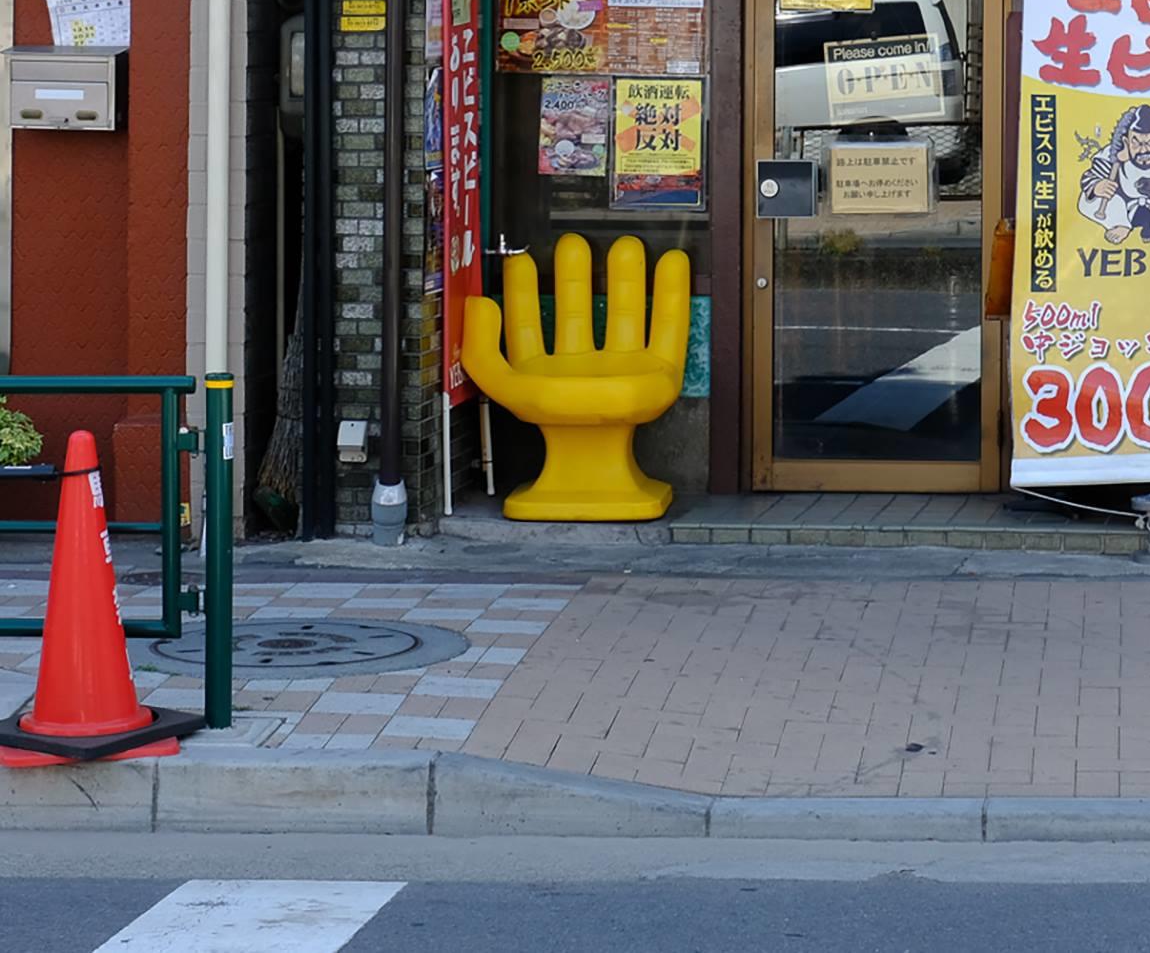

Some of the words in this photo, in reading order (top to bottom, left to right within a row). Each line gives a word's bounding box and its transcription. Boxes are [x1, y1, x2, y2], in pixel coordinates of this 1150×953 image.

[833, 47, 875, 61] Please
[878, 44, 912, 57] come
[837, 61, 934, 96] OPEN
[628, 84, 690, 100] 飲酒運転
[635, 103, 683, 126] 絶対
[635, 128, 682, 152] 反対
